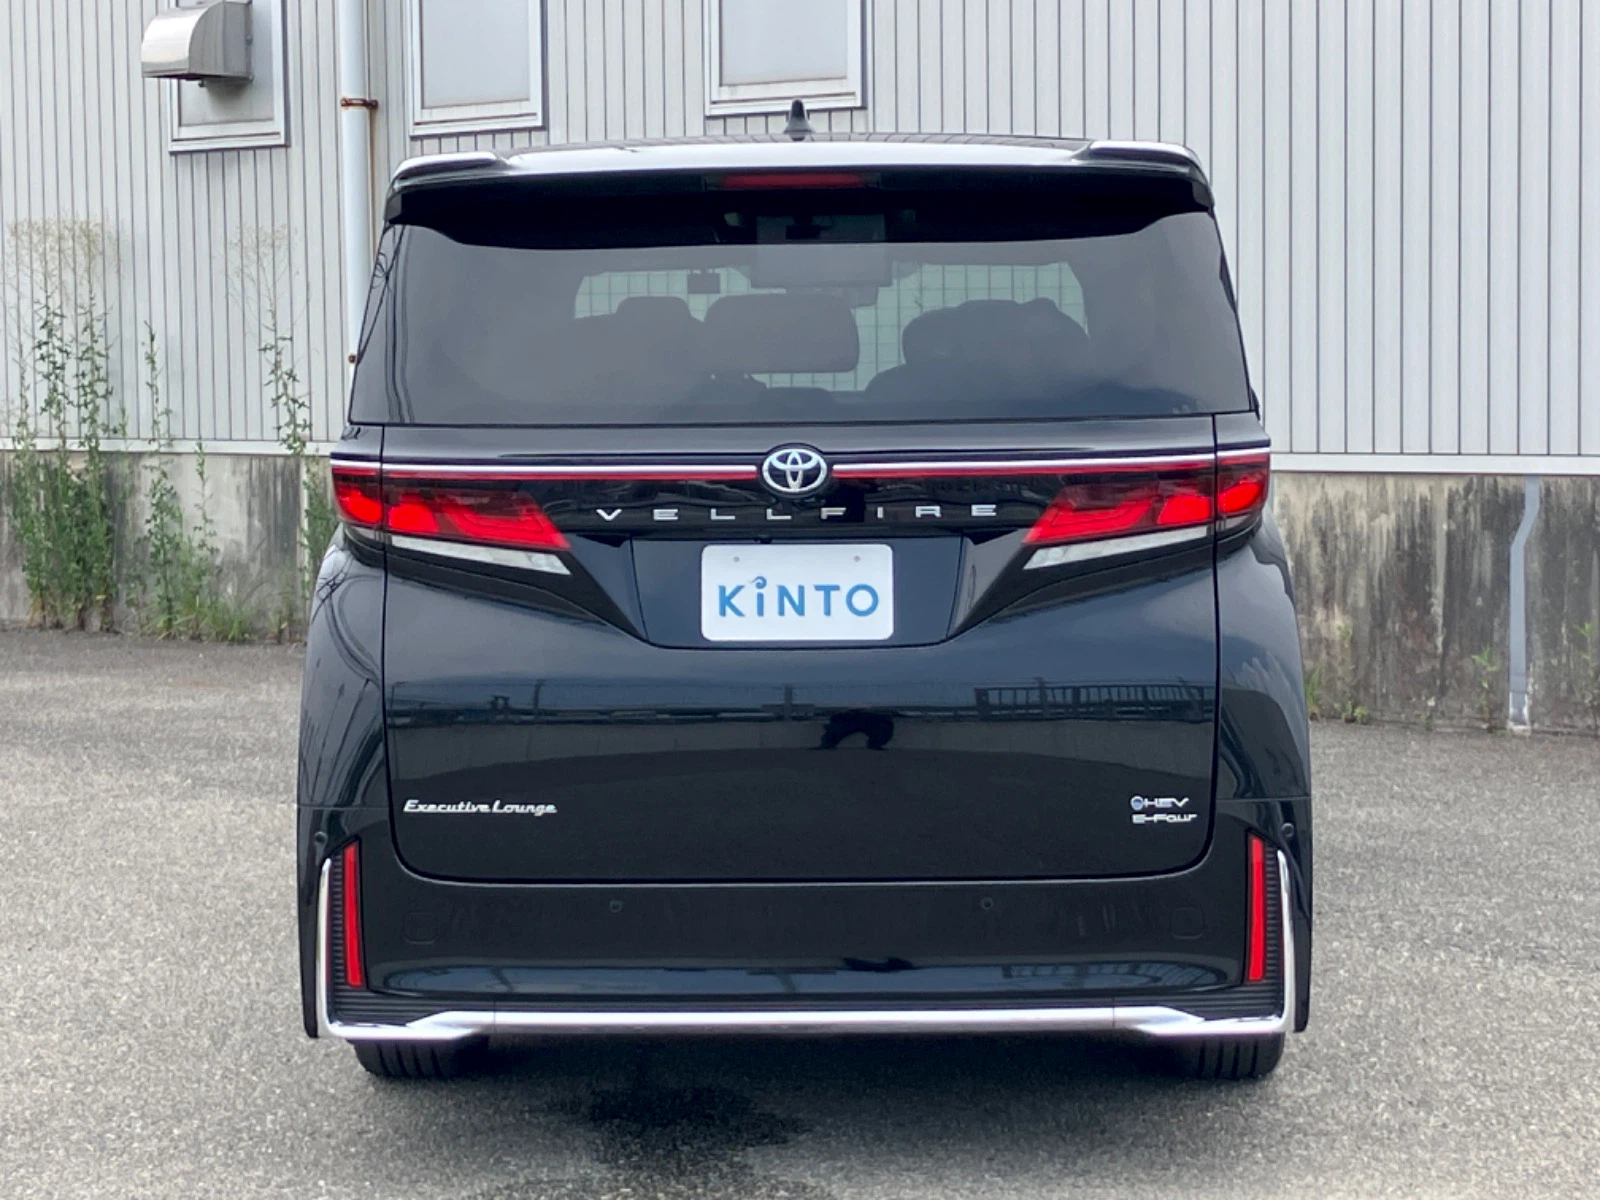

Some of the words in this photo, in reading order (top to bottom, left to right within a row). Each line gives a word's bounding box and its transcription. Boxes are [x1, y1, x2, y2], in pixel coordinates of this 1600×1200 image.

[596, 503, 998, 522] VELLFIRE
[402, 799, 491, 813] Executive
[491, 799, 559, 817] Lounge
